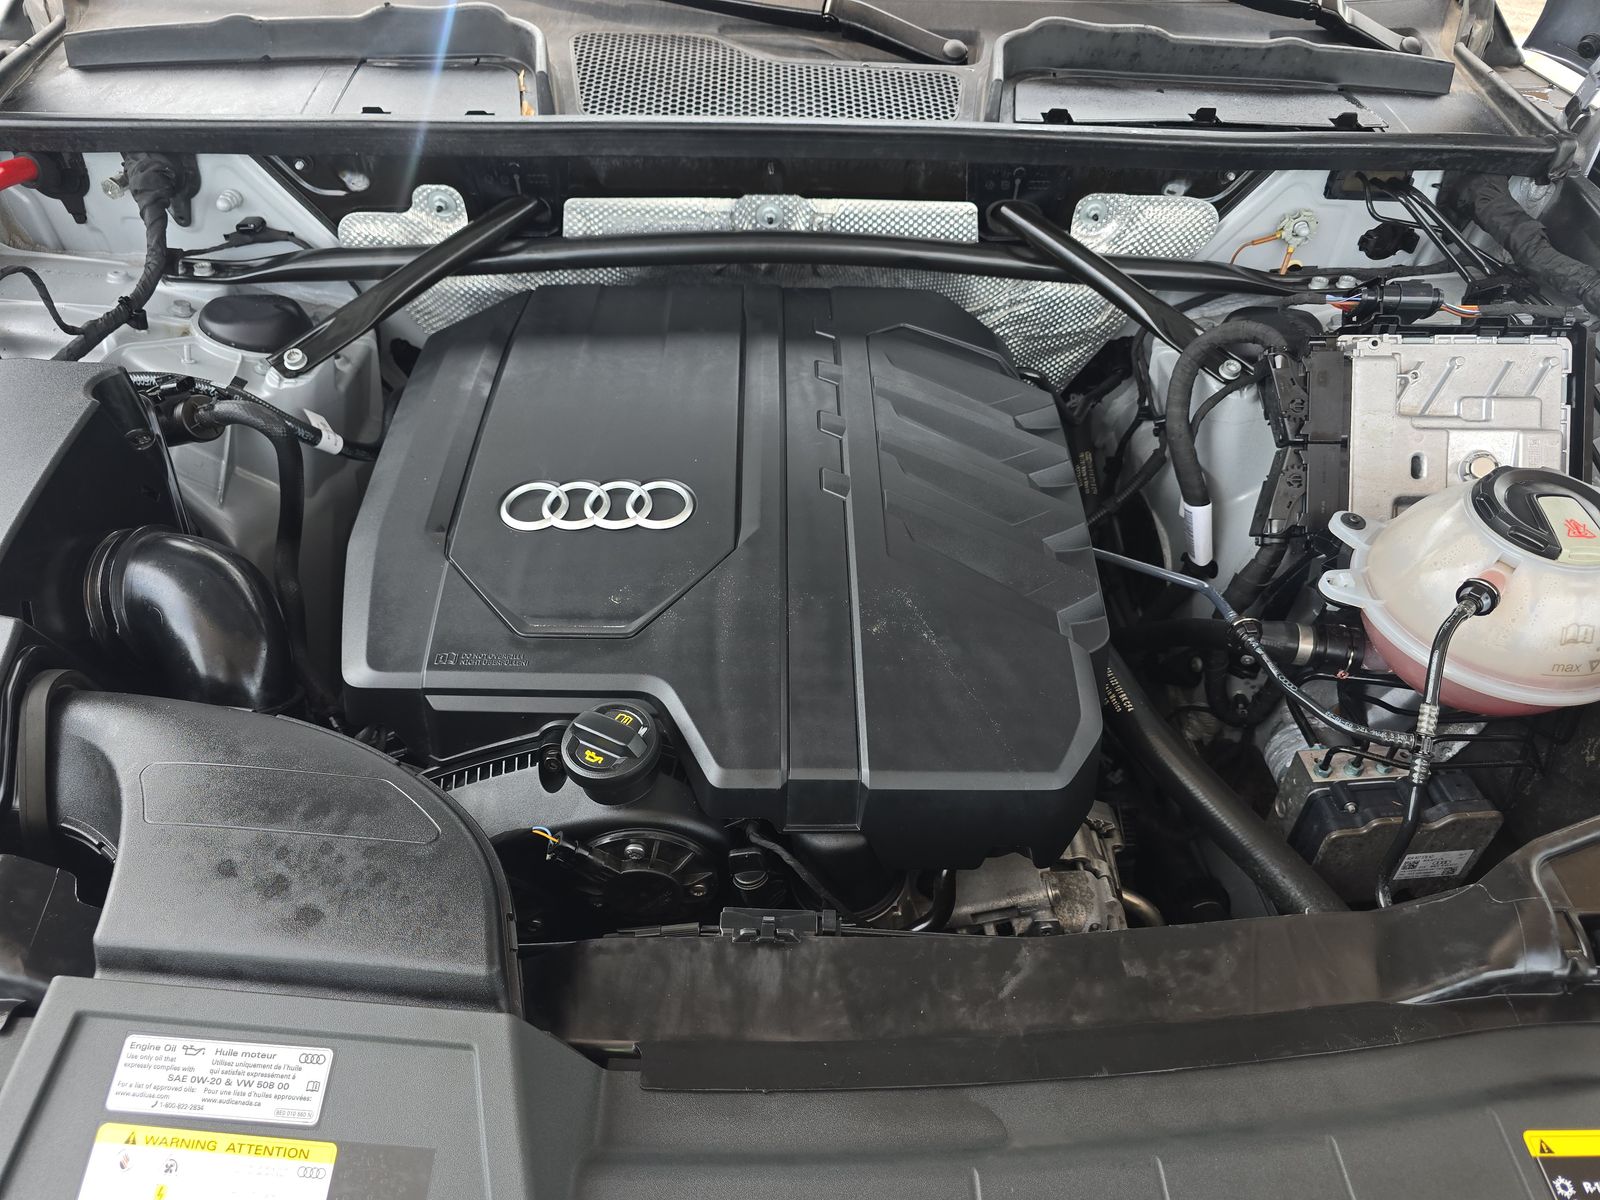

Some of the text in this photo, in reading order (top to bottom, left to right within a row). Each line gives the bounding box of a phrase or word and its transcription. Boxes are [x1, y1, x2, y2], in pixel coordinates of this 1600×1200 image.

[1552, 661, 1583, 672] max
[130, 1042, 177, 1052] Engine Oil
[140, 1053, 153, 1061] only
[215, 1048, 277, 1060] Huile moteur
[124, 1062, 152, 1070] expressly
[153, 1063, 180, 1072] complies
[211, 1059, 234, 1067] Utilisez
[235, 1061, 273, 1069] uniquement
[168, 1074, 188, 1083] SAE
[190, 1075, 222, 1086] 0W-20
[236, 1079, 254, 1088] VW
[256, 1080, 275, 1089] 508
[144, 1135, 310, 1160] WARNING ATTENTION
[1582, 1181, 1600, 1194] R-1
